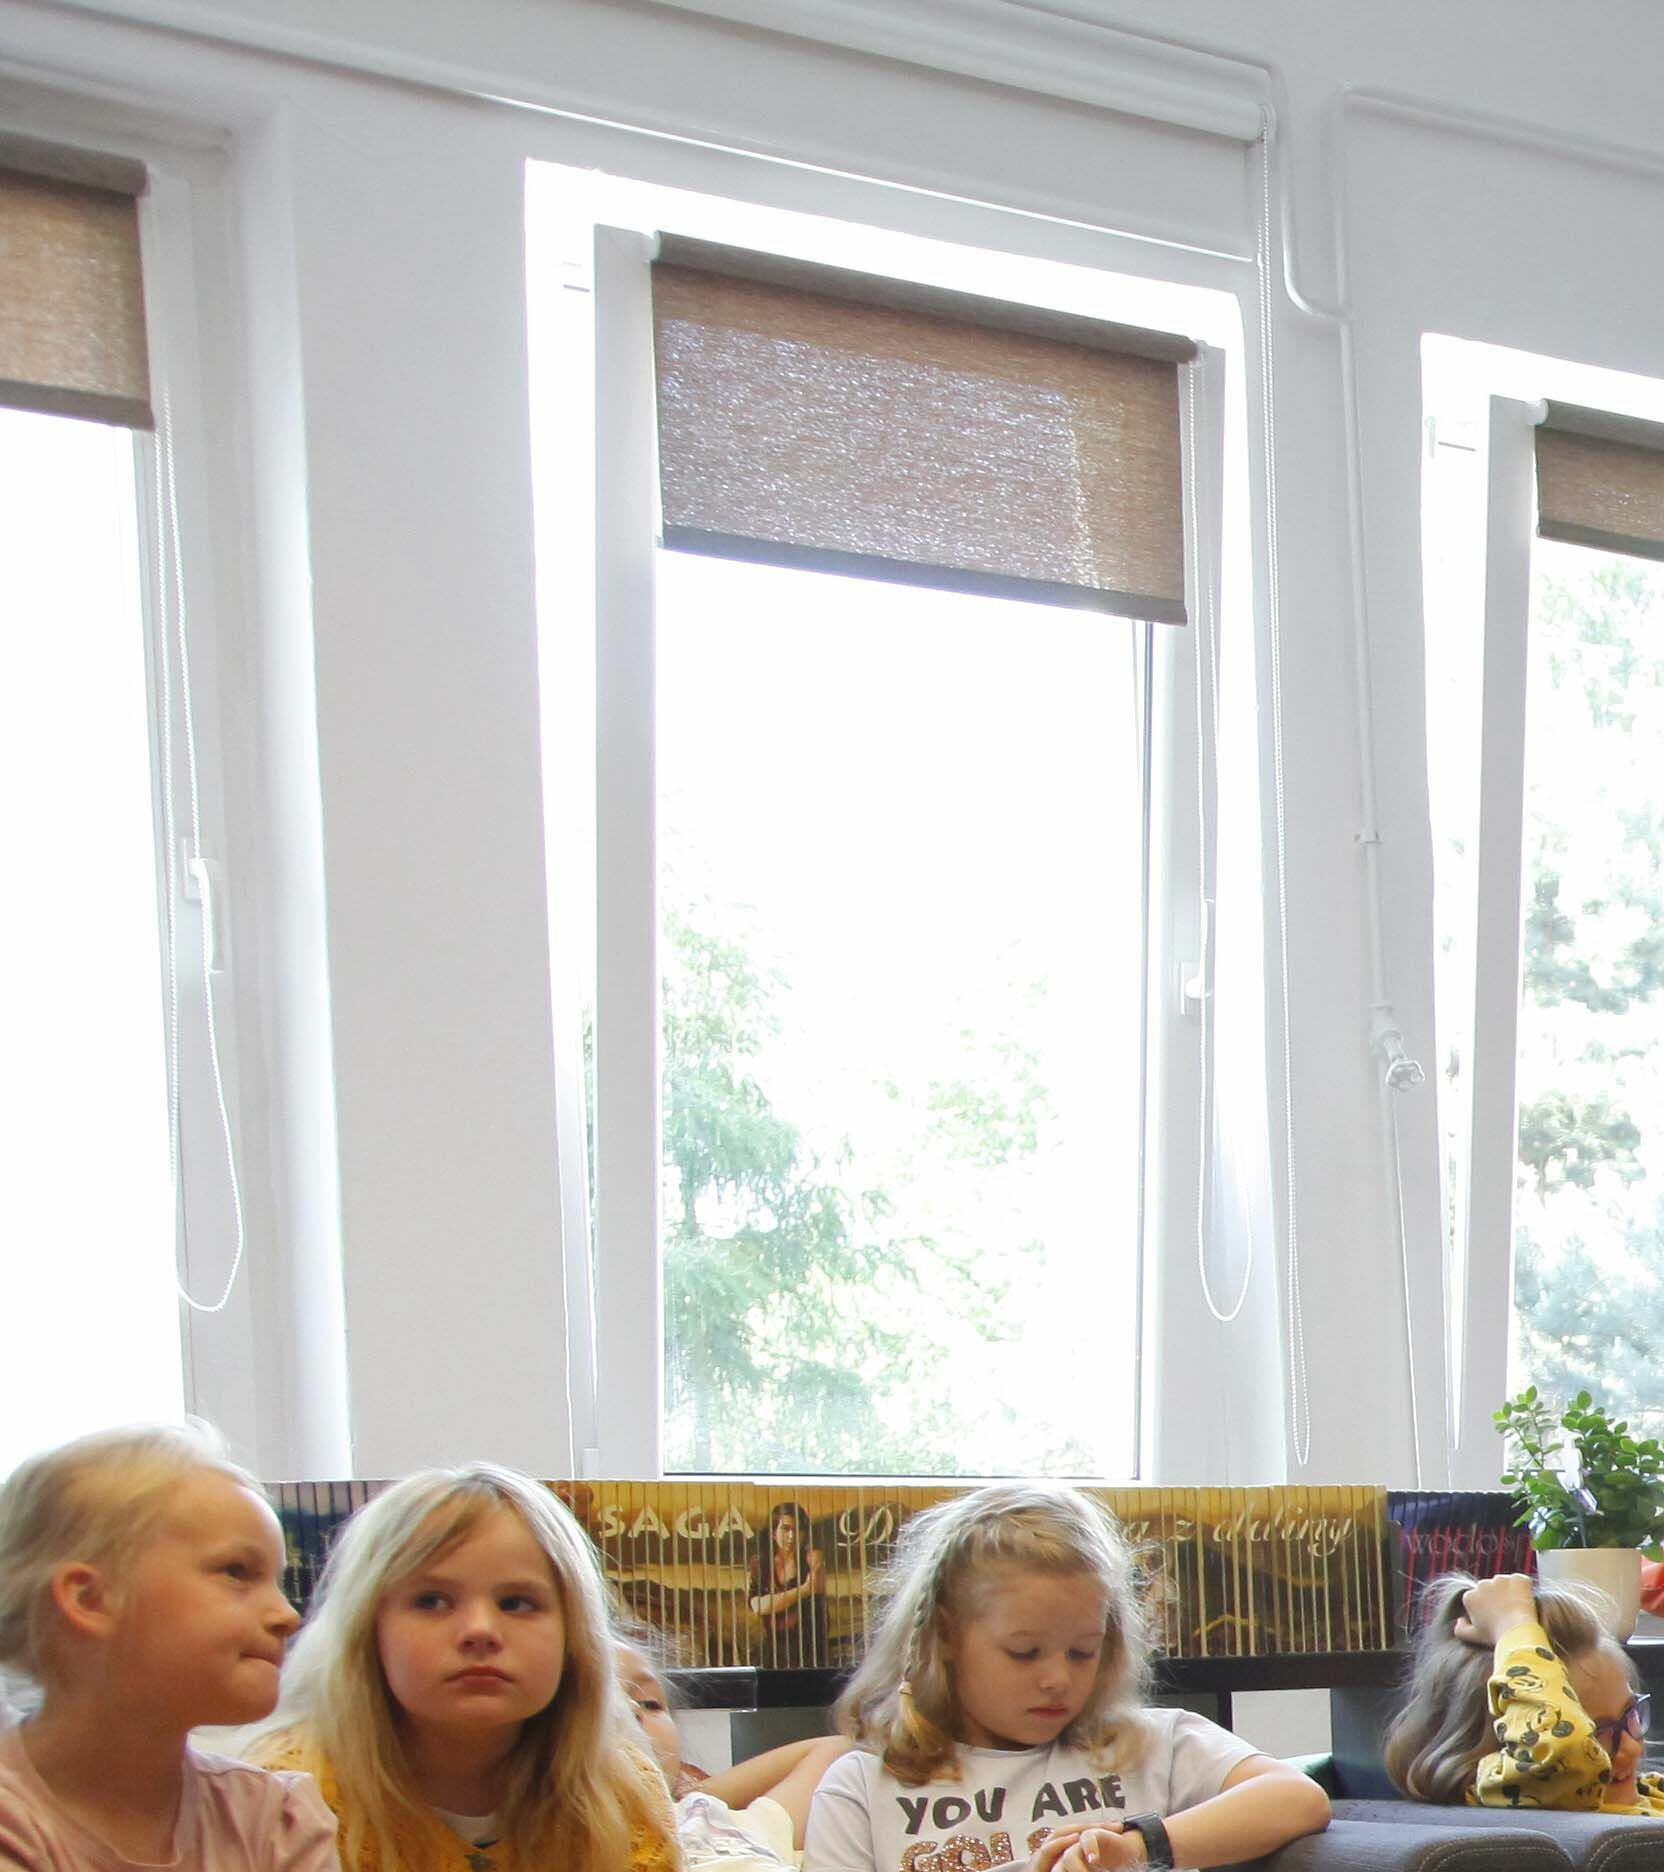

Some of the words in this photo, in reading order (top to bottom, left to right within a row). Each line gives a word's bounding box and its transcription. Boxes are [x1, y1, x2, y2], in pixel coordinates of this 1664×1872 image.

[597, 1502, 755, 1541] SAGA
[896, 1786, 1009, 1835] YOU
[1031, 1775, 1128, 1822] ARE
